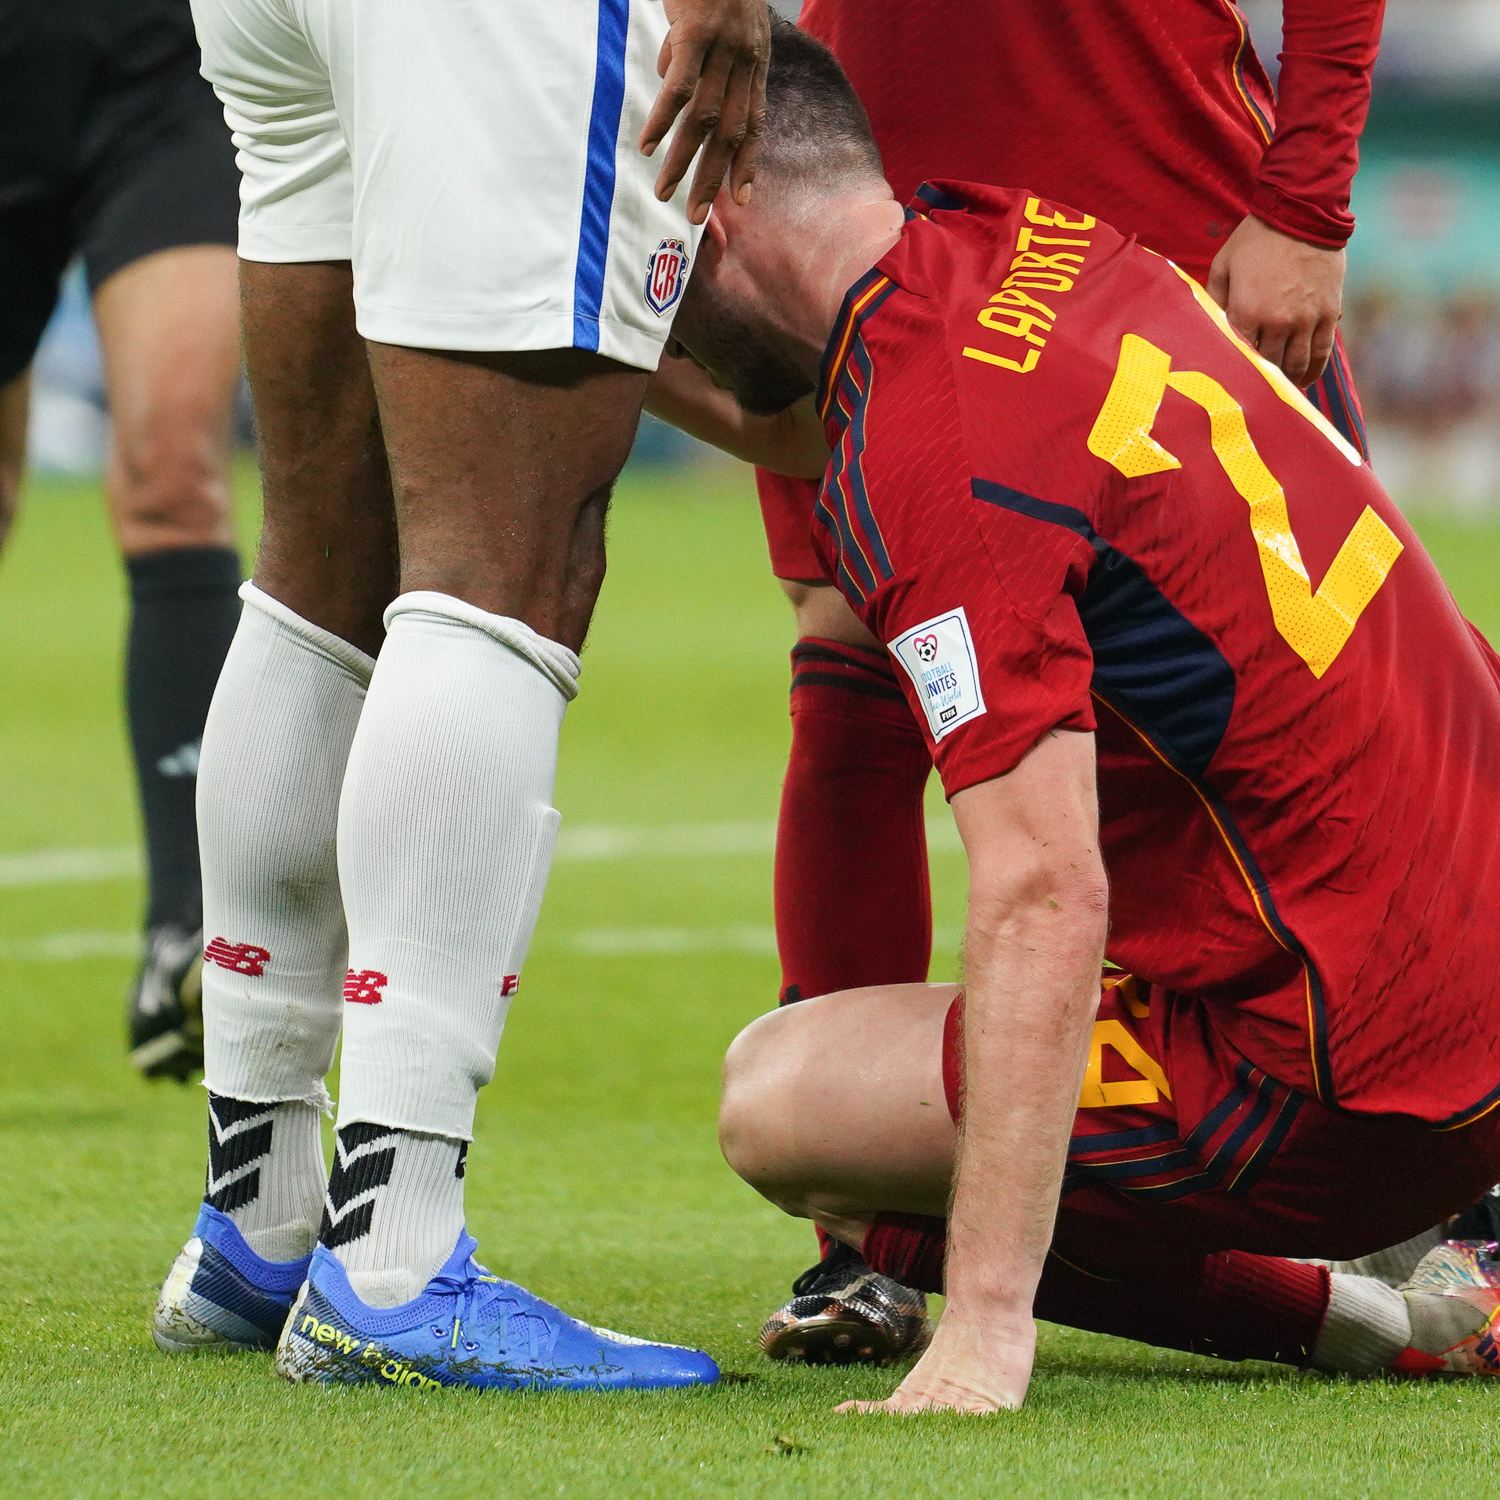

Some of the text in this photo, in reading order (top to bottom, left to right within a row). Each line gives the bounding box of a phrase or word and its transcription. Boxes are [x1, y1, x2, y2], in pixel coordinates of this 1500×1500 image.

[653, 254, 679, 301] CR
[962, 196, 1096, 374] LAPORTE
[920, 661, 954, 683] OOTBALL
[940, 686, 962, 709] World
[941, 708, 957, 721] FIFA
[300, 1314, 361, 1355] new
